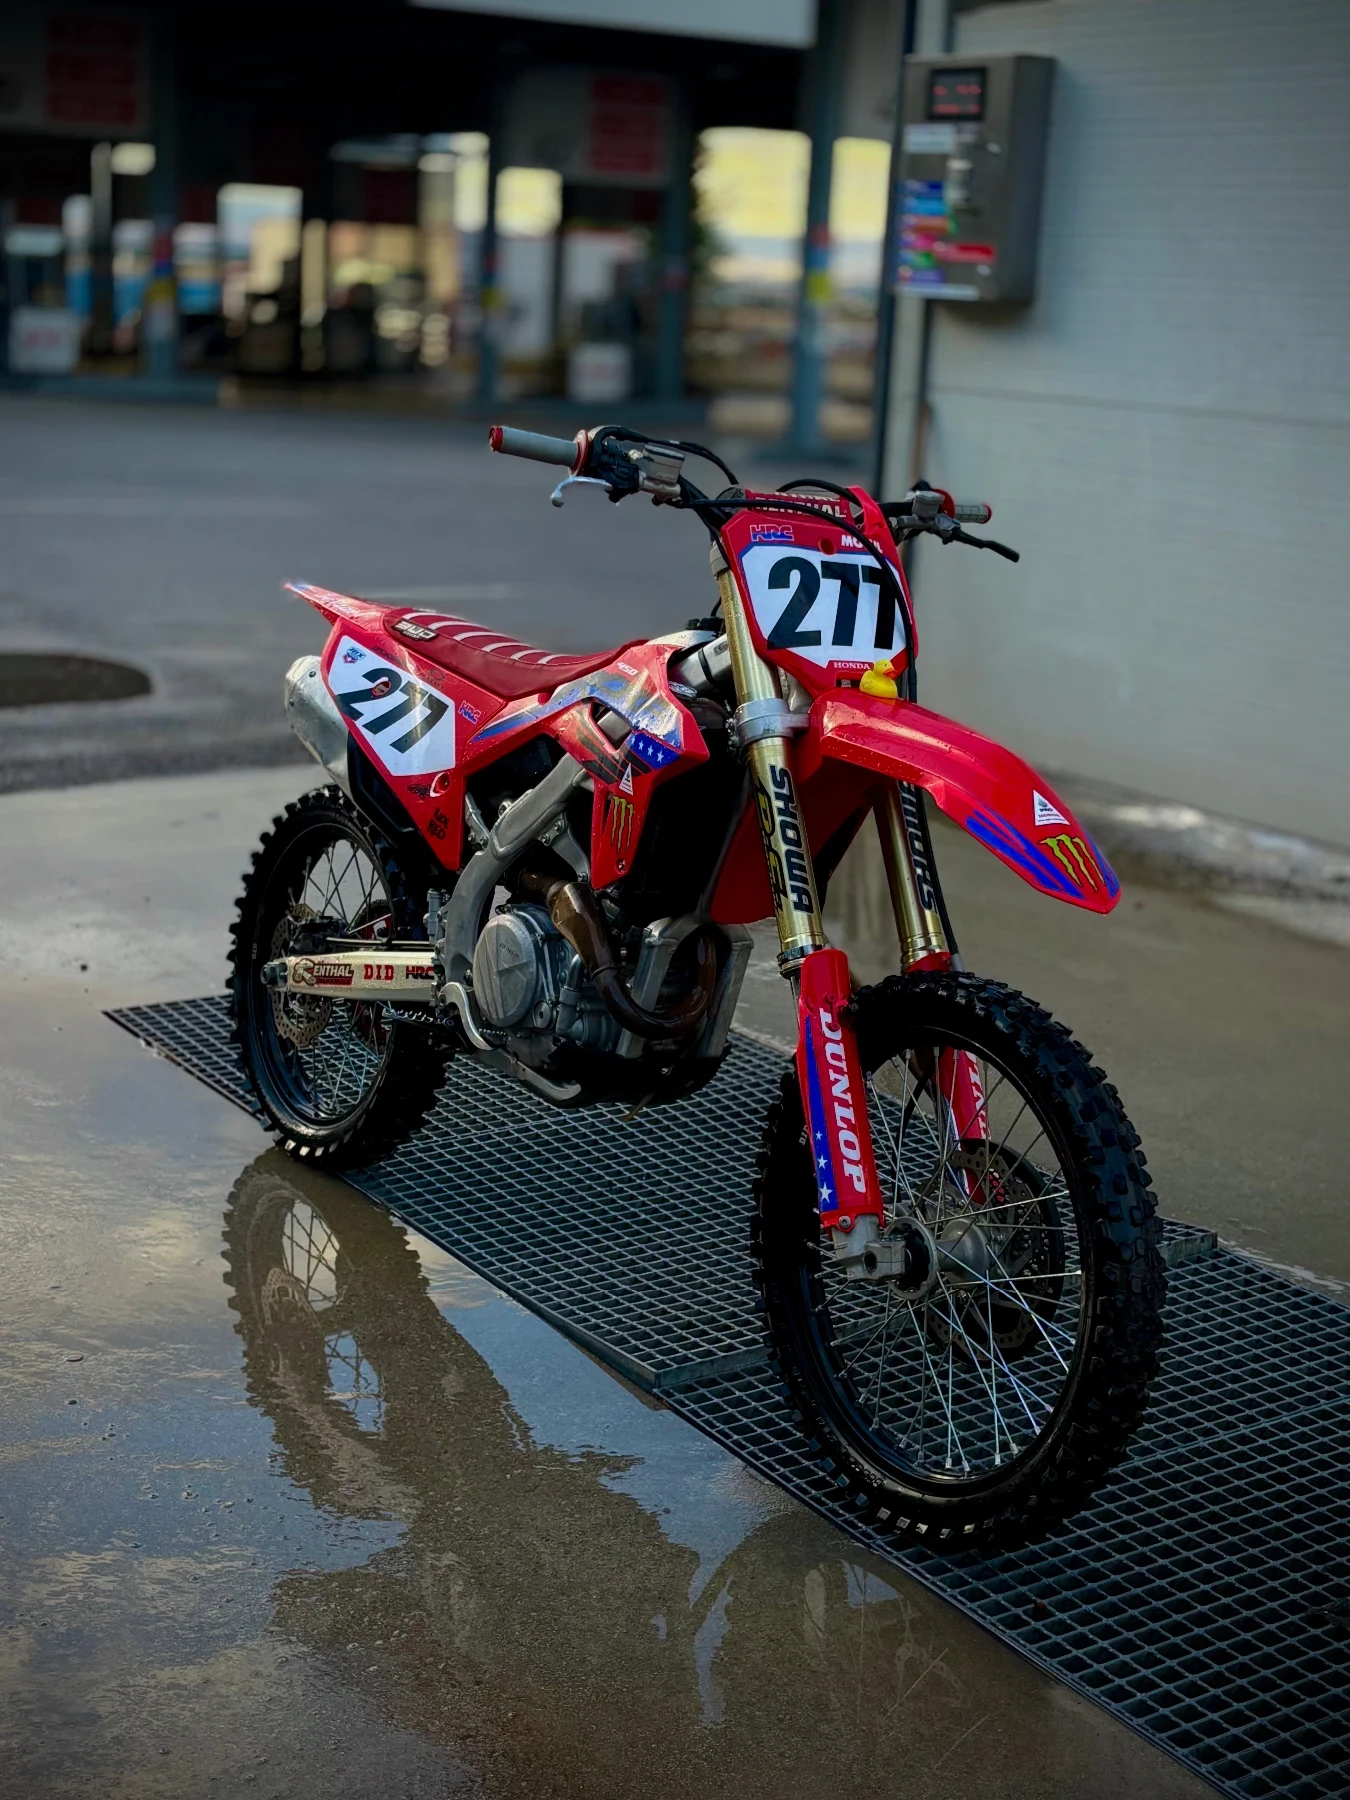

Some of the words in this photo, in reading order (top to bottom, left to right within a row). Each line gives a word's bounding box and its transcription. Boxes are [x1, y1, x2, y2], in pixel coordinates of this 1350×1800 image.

[749, 524, 795, 542] HRC
[841, 534, 883, 554] MOUL
[766, 556, 898, 650] 277
[616, 662, 639, 676] 450
[833, 661, 871, 671] HONDA
[335, 667, 450, 754] 277
[458, 700, 482, 725] HRC
[769, 763, 814, 915] SHOWA
[818, 1007, 867, 1194] DUNLOP
